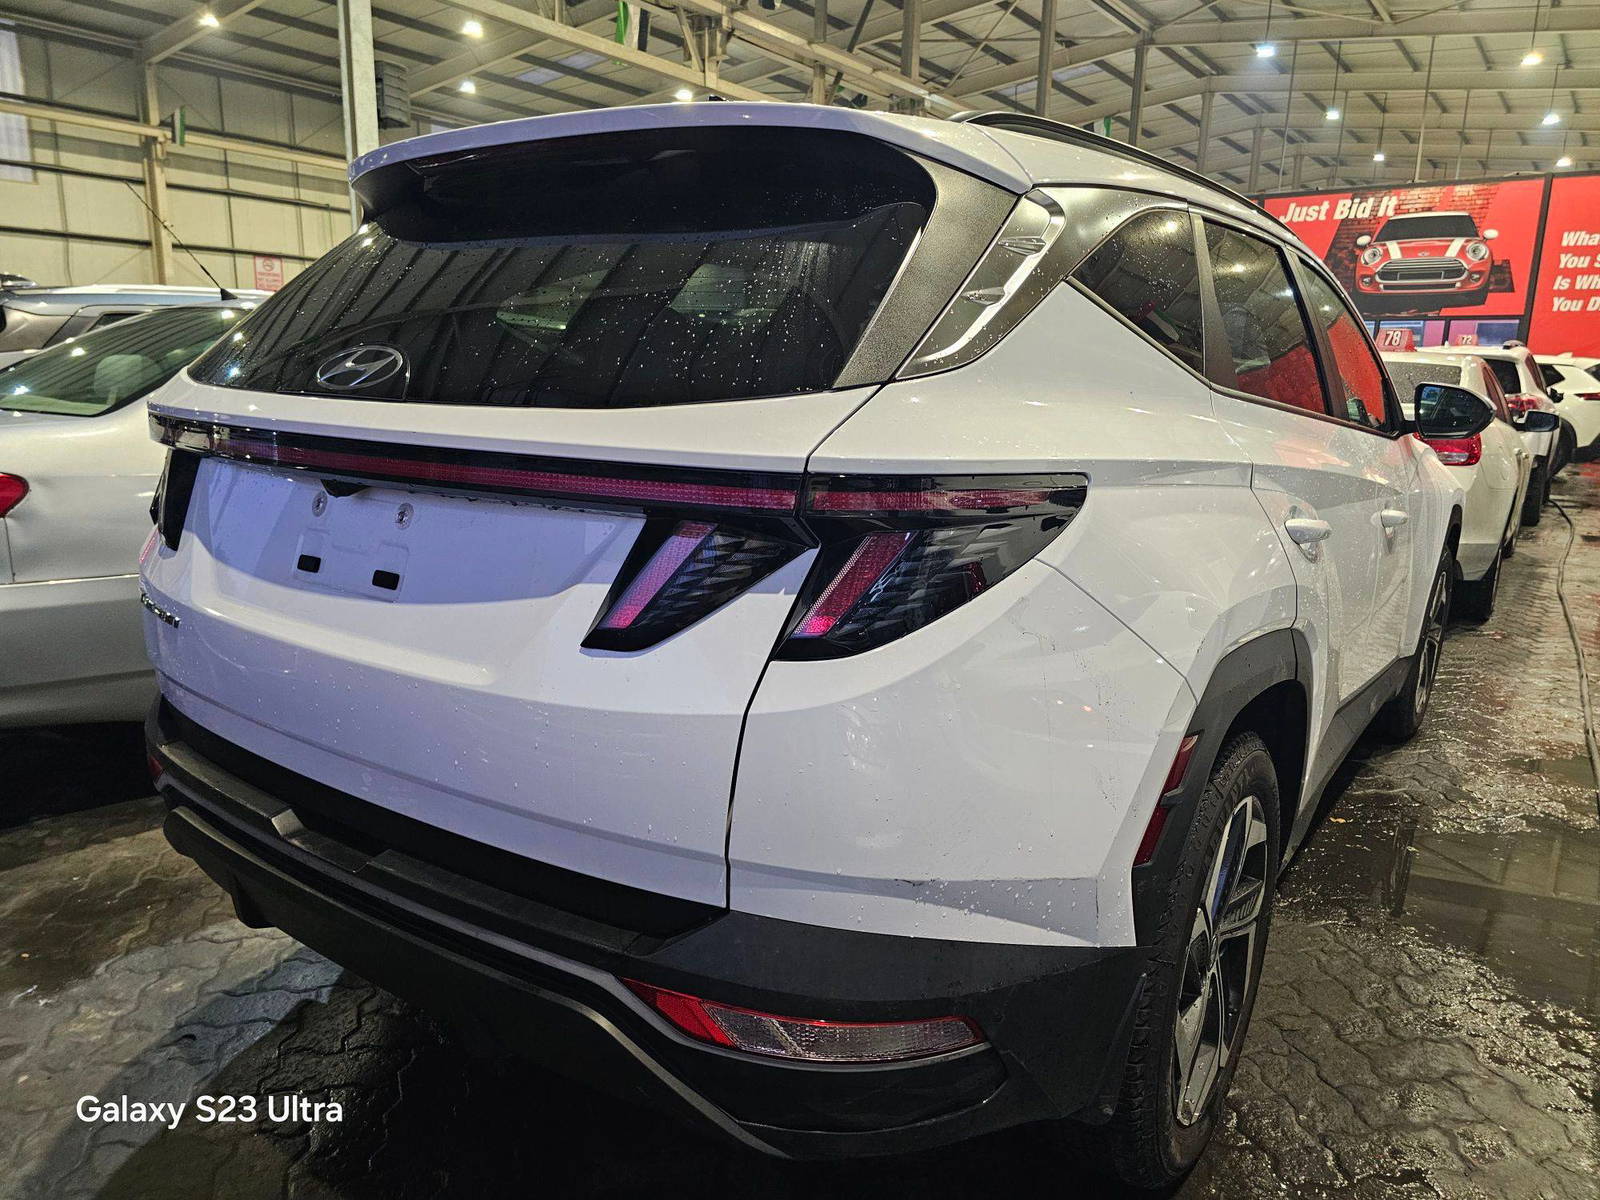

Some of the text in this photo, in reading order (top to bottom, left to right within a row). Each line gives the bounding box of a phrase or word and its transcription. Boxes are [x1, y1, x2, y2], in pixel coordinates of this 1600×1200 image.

[1279, 195, 1398, 223] Just Bid It
[1559, 253, 1591, 269] You
[1553, 275, 1571, 290] Is
[1552, 296, 1584, 312] You
[1384, 330, 1402, 346] 78
[1461, 335, 1472, 344] 72
